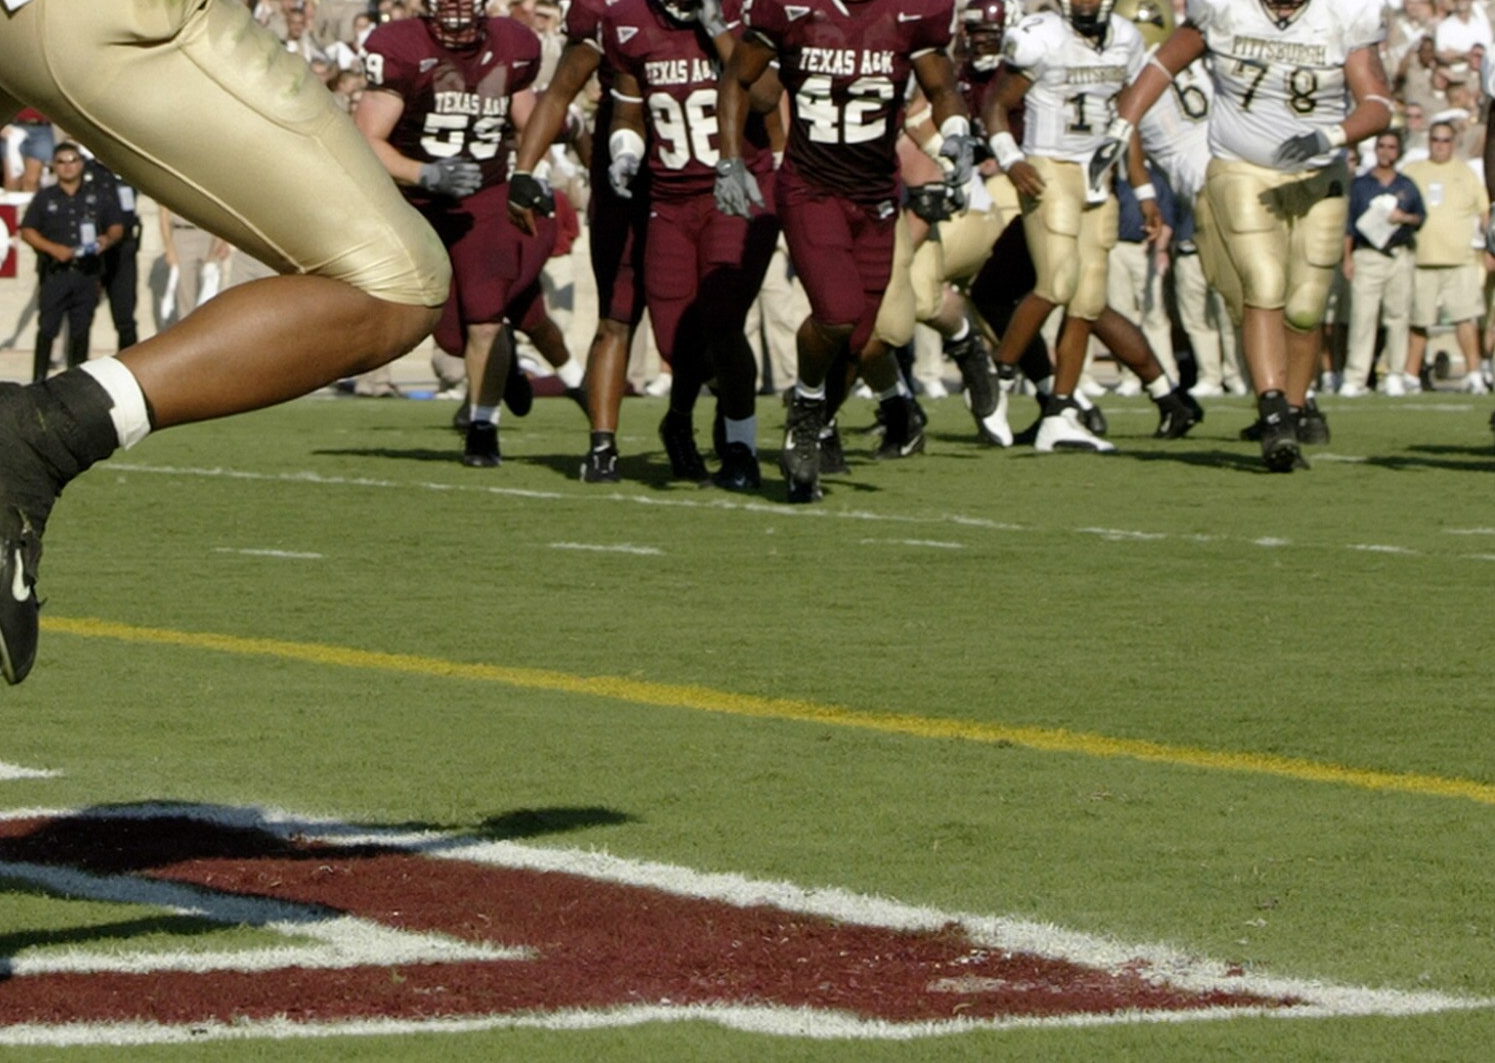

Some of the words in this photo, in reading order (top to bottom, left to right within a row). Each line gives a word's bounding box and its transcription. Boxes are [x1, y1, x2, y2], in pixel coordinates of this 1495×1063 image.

[799, 47, 855, 75] TEXAS
[1232, 34, 1328, 66] PITTSBURGH
[645, 60, 688, 85] TEXAS
[435, 91, 480, 115] TEXAS
[1232, 60, 1320, 118] 78
[796, 74, 894, 144] 42
